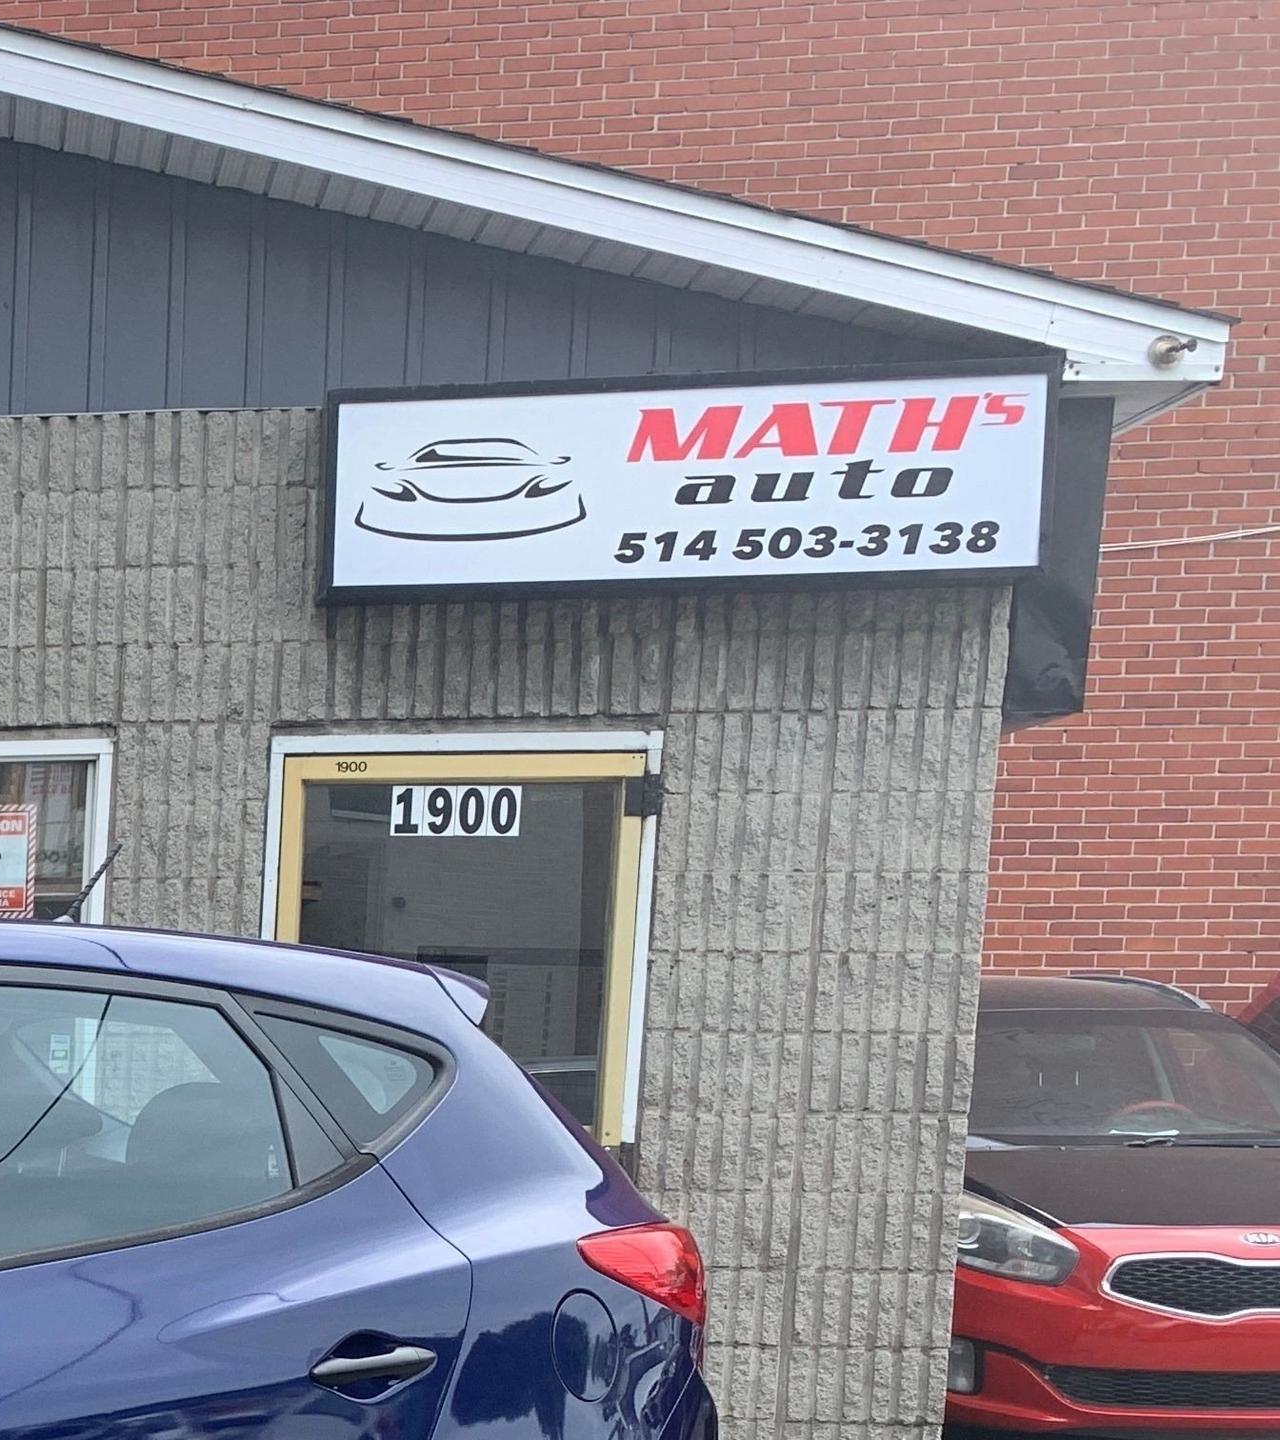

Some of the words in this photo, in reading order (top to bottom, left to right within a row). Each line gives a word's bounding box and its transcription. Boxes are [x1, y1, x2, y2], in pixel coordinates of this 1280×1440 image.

[674, 459, 954, 505] auto
[614, 528, 717, 564] 514
[732, 520, 1001, 560] 503-3138
[335, 761, 368, 773] 1900
[393, 786, 518, 835] 1900
